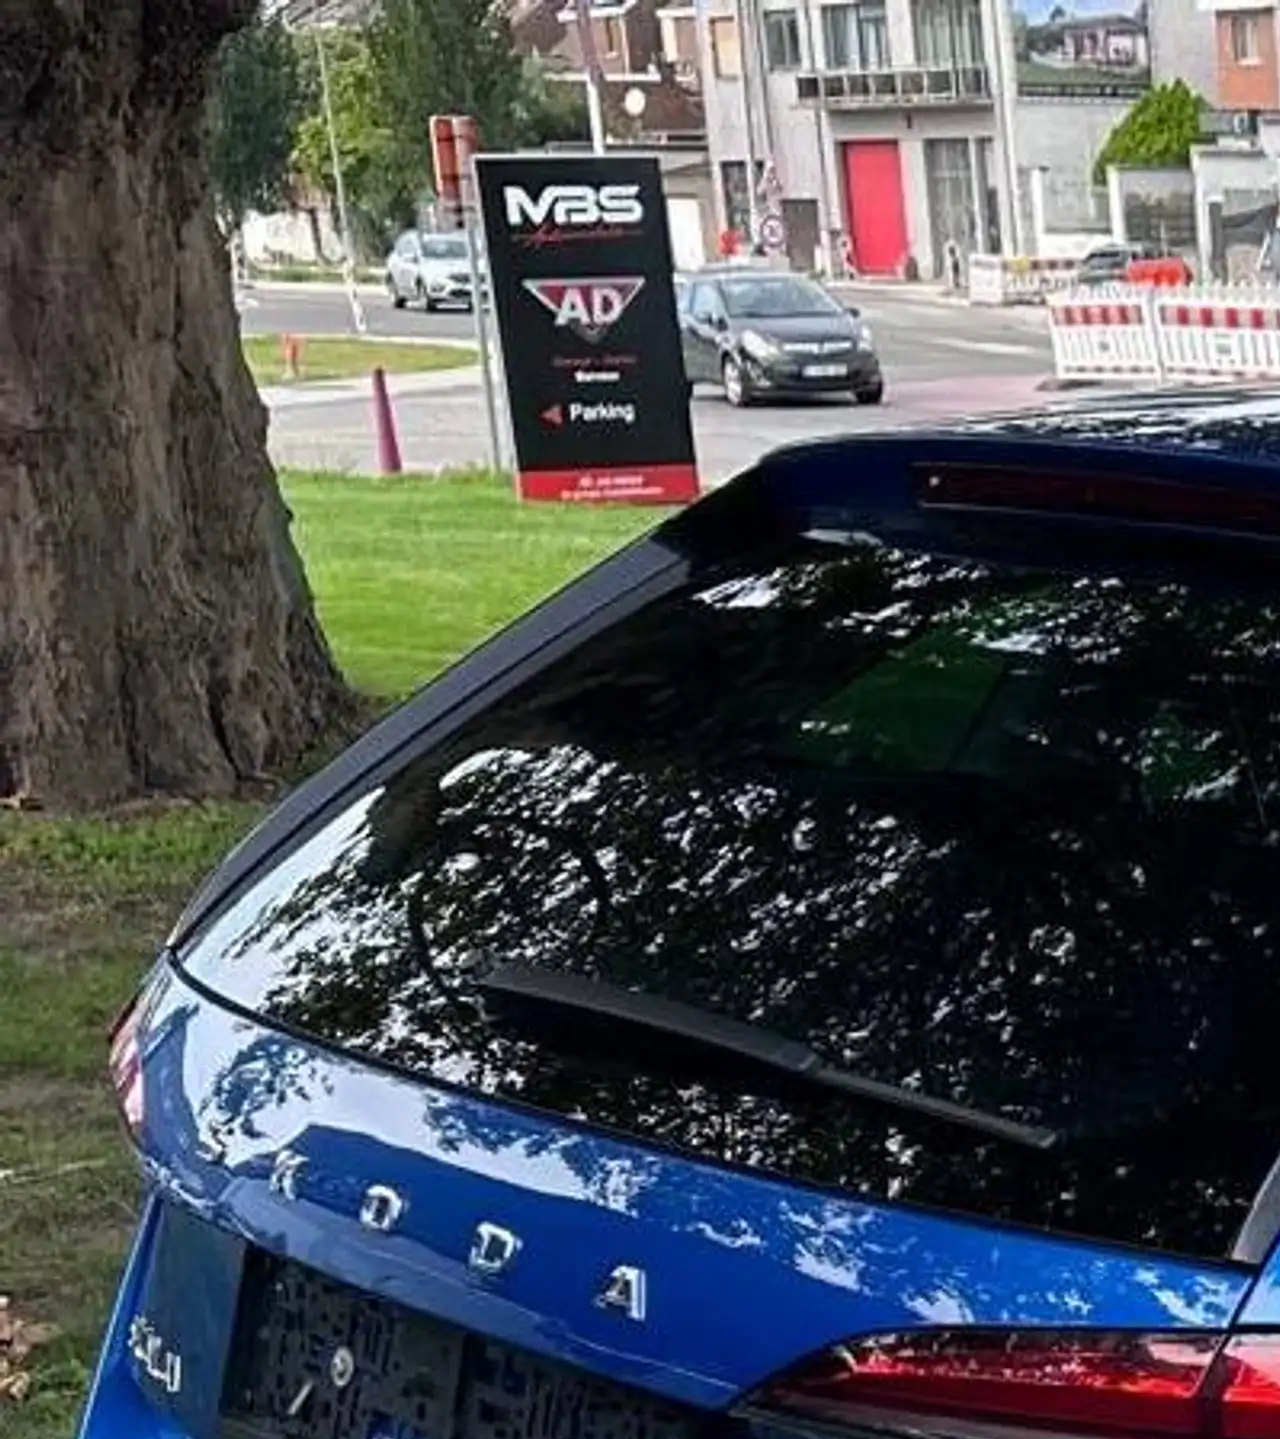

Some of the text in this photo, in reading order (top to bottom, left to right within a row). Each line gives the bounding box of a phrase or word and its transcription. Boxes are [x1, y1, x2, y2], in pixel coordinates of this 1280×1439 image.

[503, 184, 644, 224] MBS
[555, 287, 623, 327] AD
[569, 402, 636, 424] Parking
